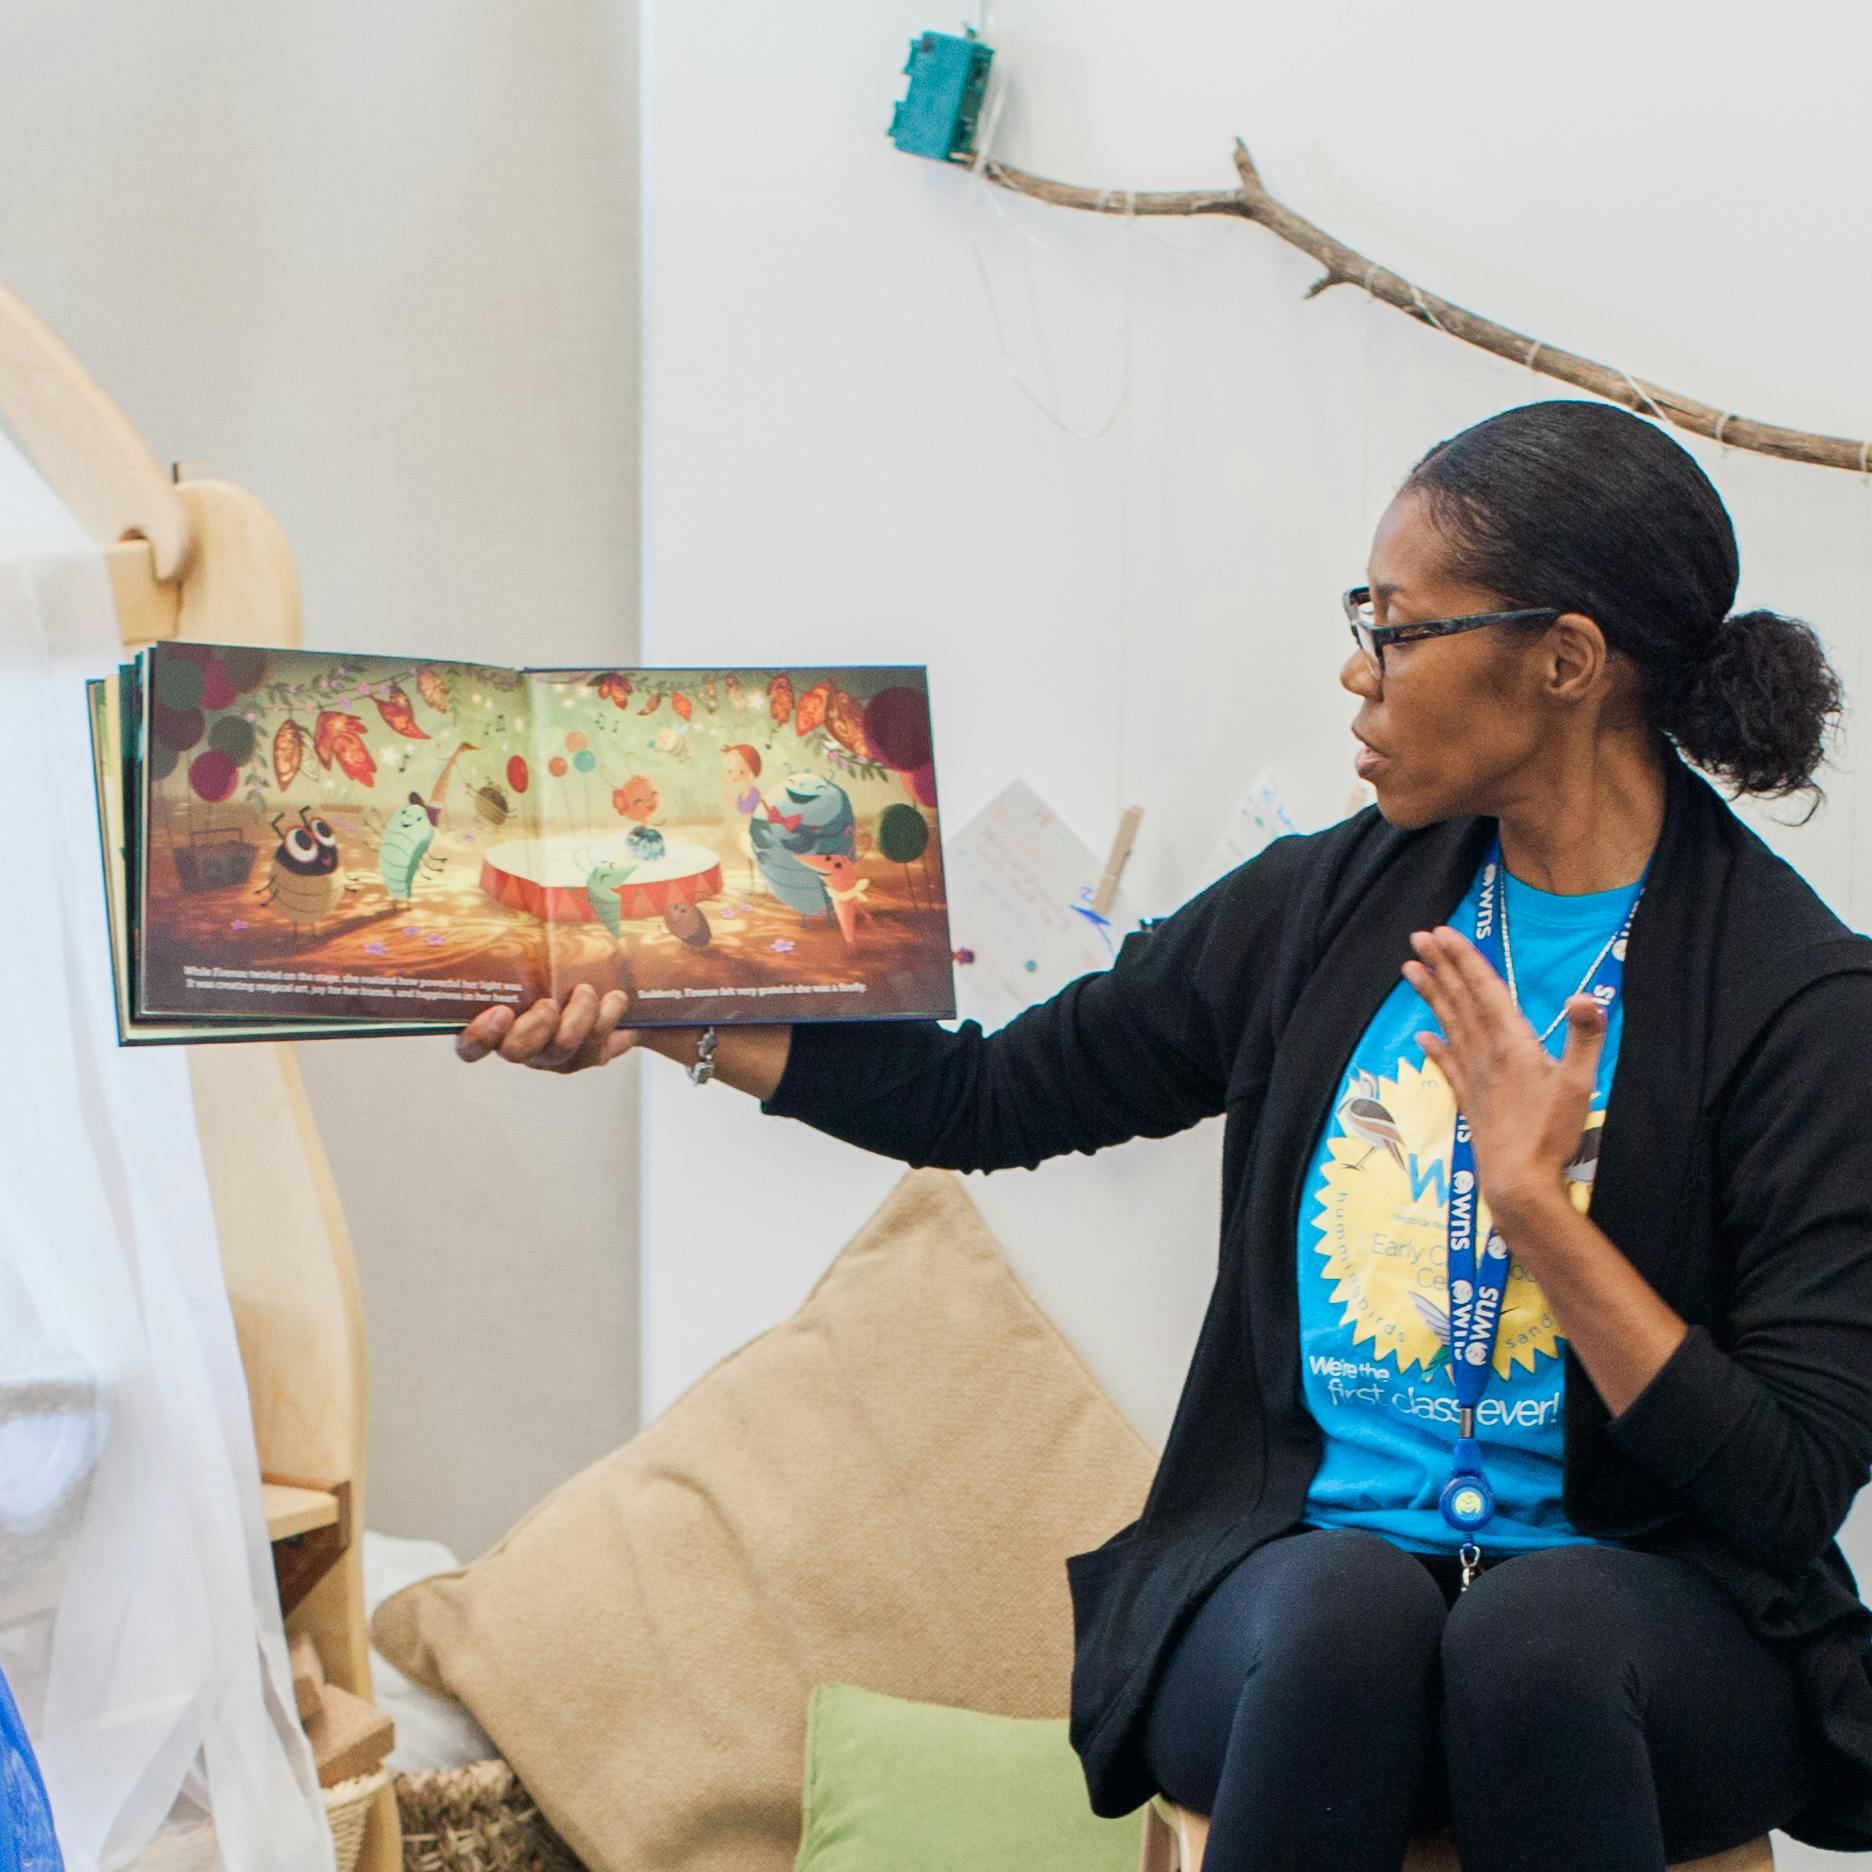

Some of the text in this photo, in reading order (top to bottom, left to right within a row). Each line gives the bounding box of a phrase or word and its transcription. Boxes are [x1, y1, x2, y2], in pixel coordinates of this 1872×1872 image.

[1476, 884, 1494, 940] wns
[1371, 1231, 1422, 1265] Early
[1450, 1193, 1472, 1252] wns
[1469, 1285, 1499, 1340] wns
[1309, 1355, 1390, 1383] We're the
[1328, 1378, 1561, 1427] first class ever!
